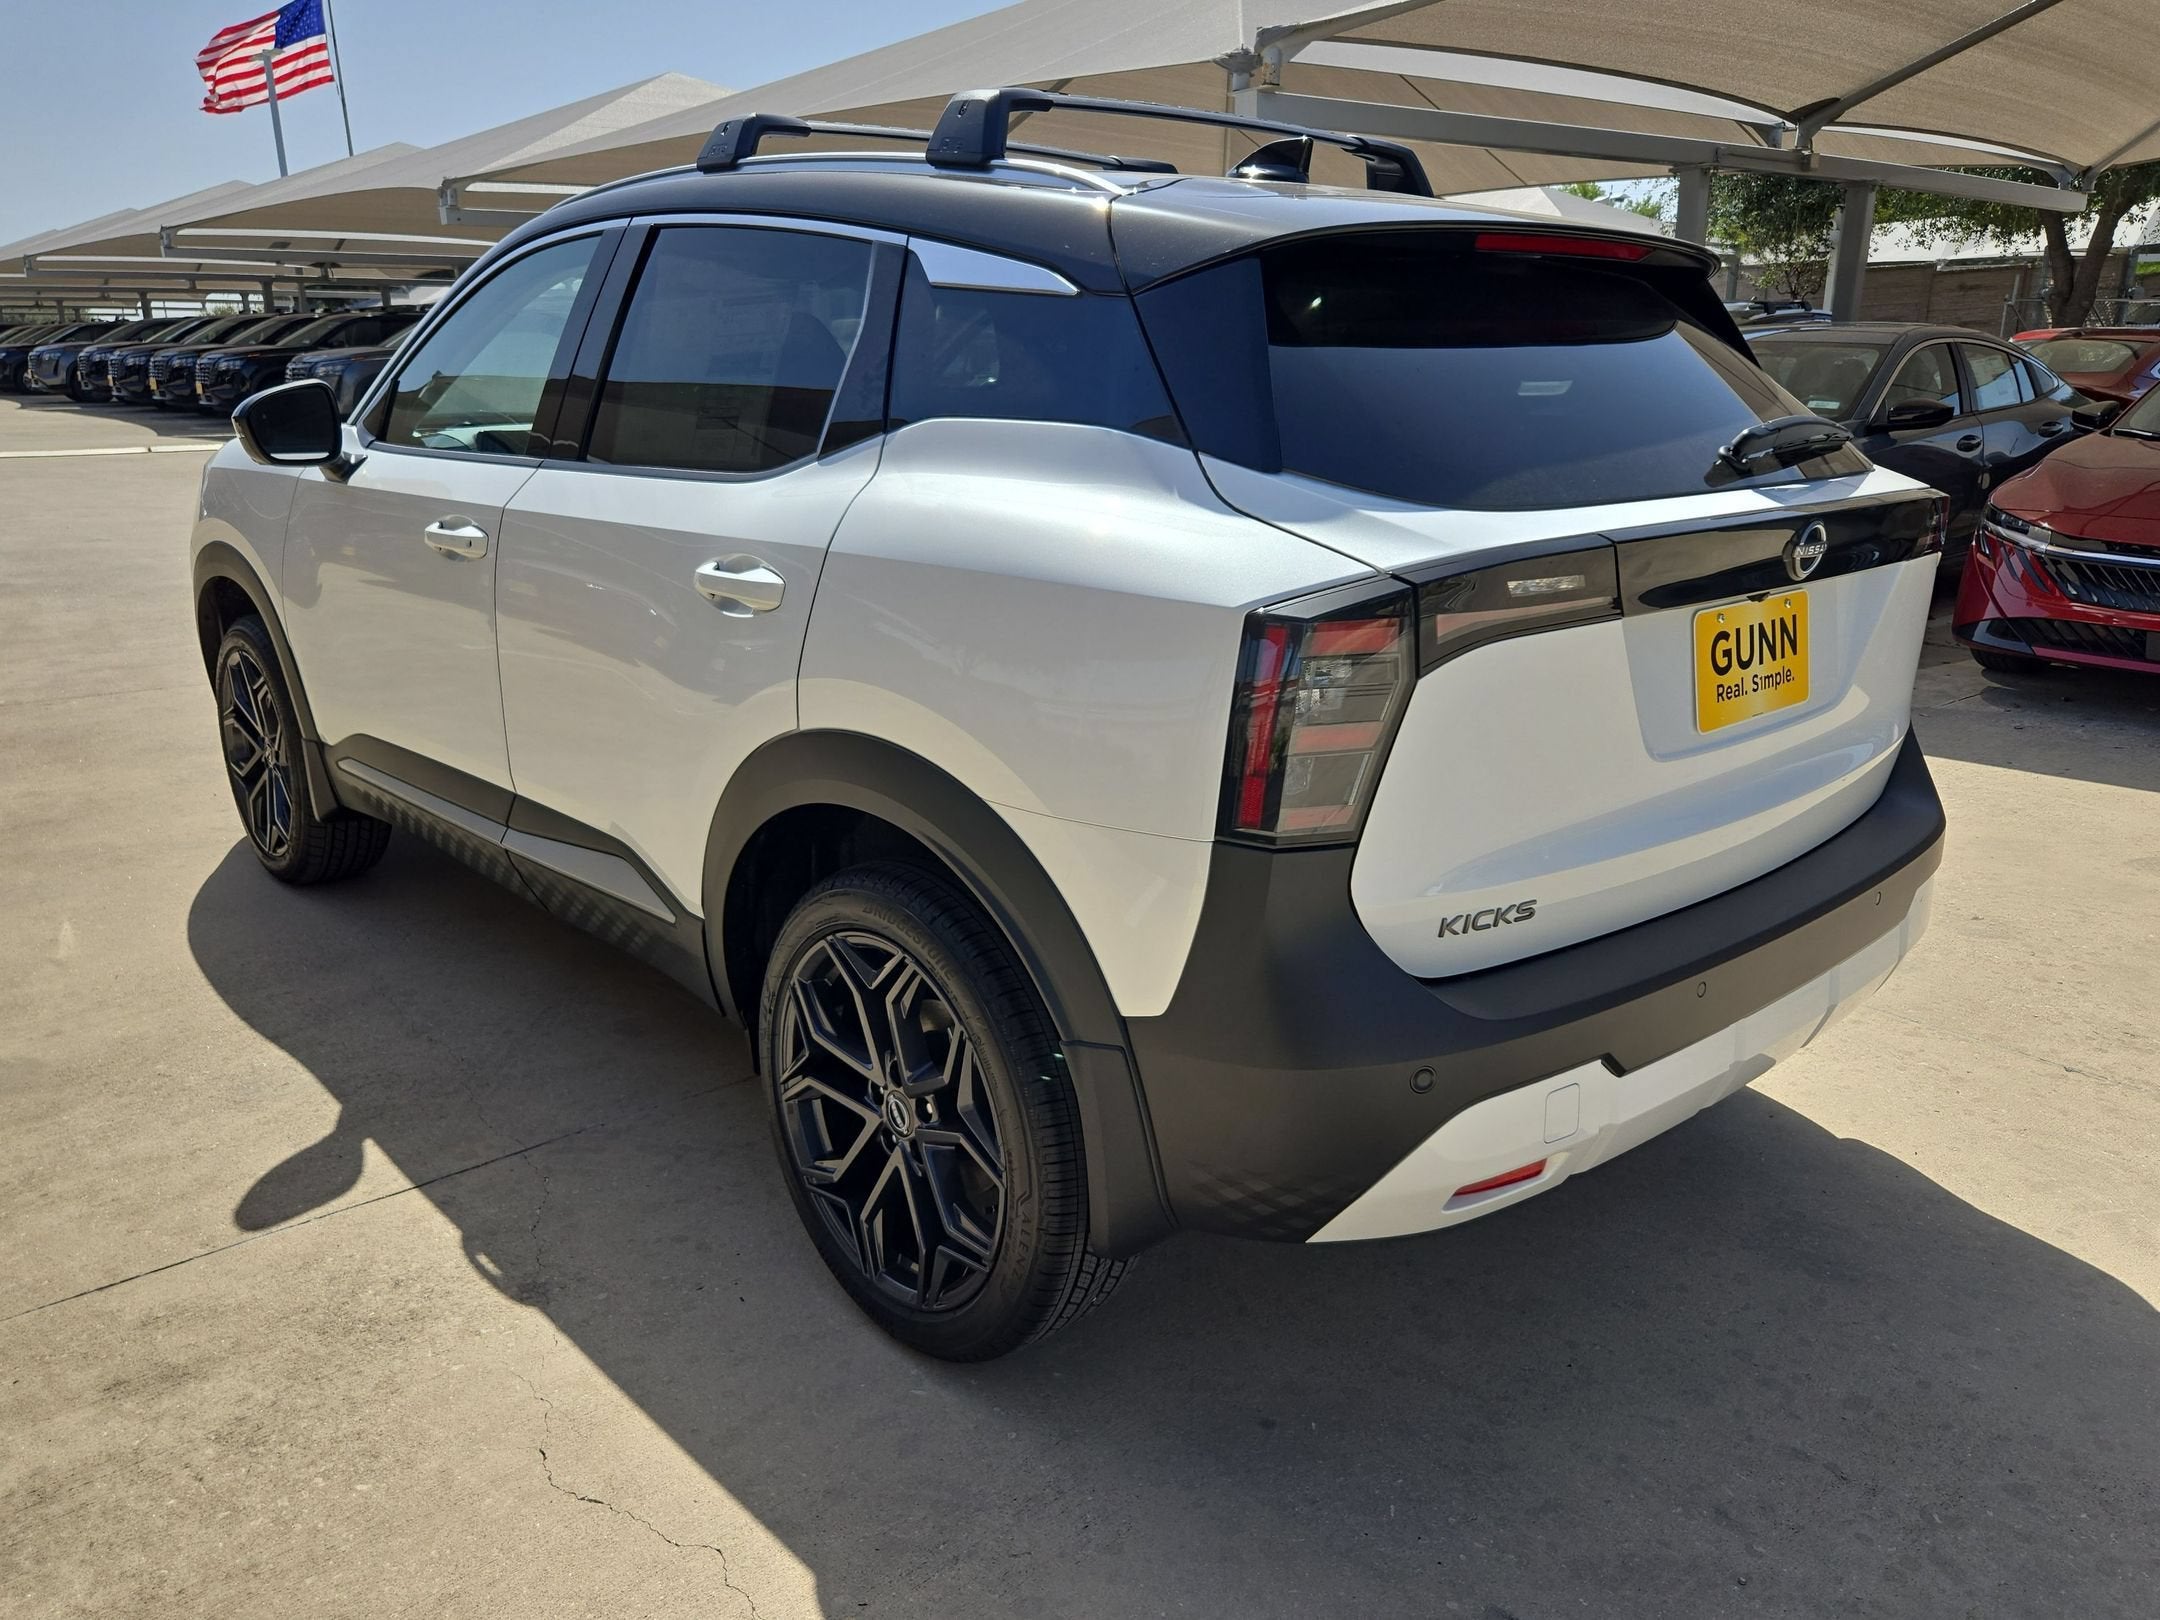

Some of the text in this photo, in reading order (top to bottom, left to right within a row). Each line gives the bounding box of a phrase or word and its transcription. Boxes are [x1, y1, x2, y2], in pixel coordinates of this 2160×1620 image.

[1794, 543, 1827, 556] NISSA
[1711, 614, 1798, 676] GUNN
[1717, 677, 1748, 703] Real.
[1438, 899, 1538, 938] KICKS
